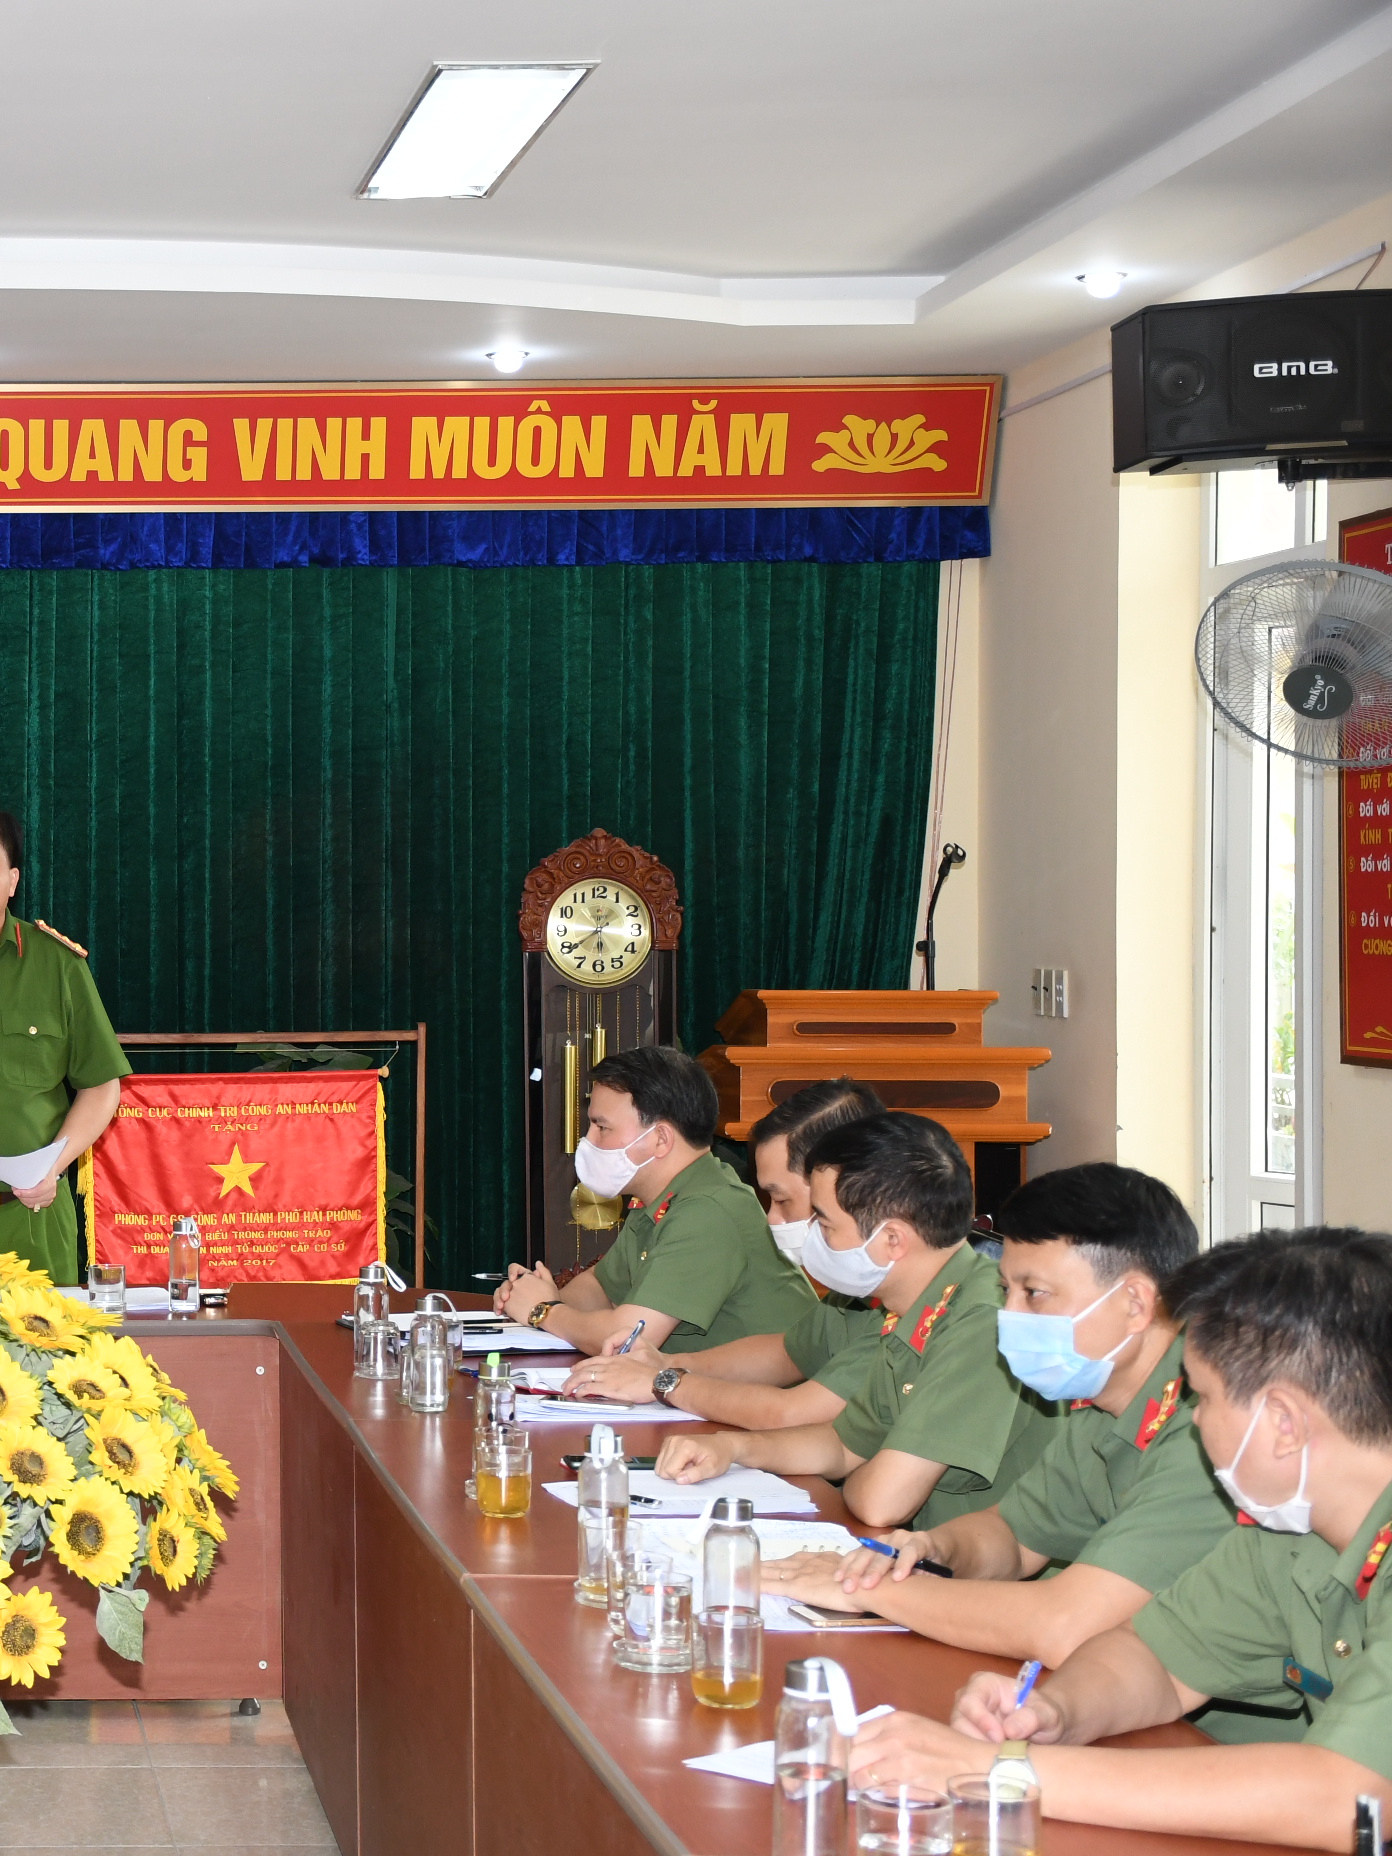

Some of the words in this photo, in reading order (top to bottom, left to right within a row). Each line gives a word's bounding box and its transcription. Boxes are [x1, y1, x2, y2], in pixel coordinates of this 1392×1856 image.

[232, 416, 387, 481] VINH
[409, 400, 607, 480] MUÔN
[628, 399, 789, 477] NĂM
[1359, 799, 1374, 817] Đối
[1376, 798, 1390, 816] với
[1360, 823, 1382, 845] KÍNH
[1360, 853, 1375, 872] Đối
[1377, 853, 1391, 872] với
[573, 891, 586, 904] 11
[591, 885, 608, 899] 12
[614, 890, 620, 903] 1
[559, 905, 574, 919] 10
[625, 904, 639, 918] 2
[1360, 909, 1379, 928] Đối
[556, 924, 568, 937] 9
[630, 923, 642, 937] 3
[560, 941, 574, 954] 8
[624, 941, 637, 954] 4
[573, 955, 586, 969] 7
[591, 959, 605, 973] 6
[610, 954, 624, 969] 5
[148, 1107, 173, 1120] CỤC
[177, 1105, 213, 1118] CHÍNH
[217, 1106, 238, 1119] TRỊ
[241, 1103, 272, 1116] CÔNG
[275, 1104, 292, 1115] AN
[295, 1099, 329, 1115] NHÂN
[332, 1099, 357, 1114] DÂN
[210, 1121, 259, 1134] TẶNG
[114, 1211, 149, 1226] PHÒNG
[221, 1212, 236, 1225] AN
[239, 1210, 274, 1224] THÀNH
[277, 1208, 301, 1223] PHỐ
[326, 1207, 362, 1222] PHÒNG
[231, 1231, 265, 1240] TRONG
[267, 1230, 299, 1239] PHONG
[130, 1245, 147, 1254] THI
[209, 1245, 232, 1254] NINH
